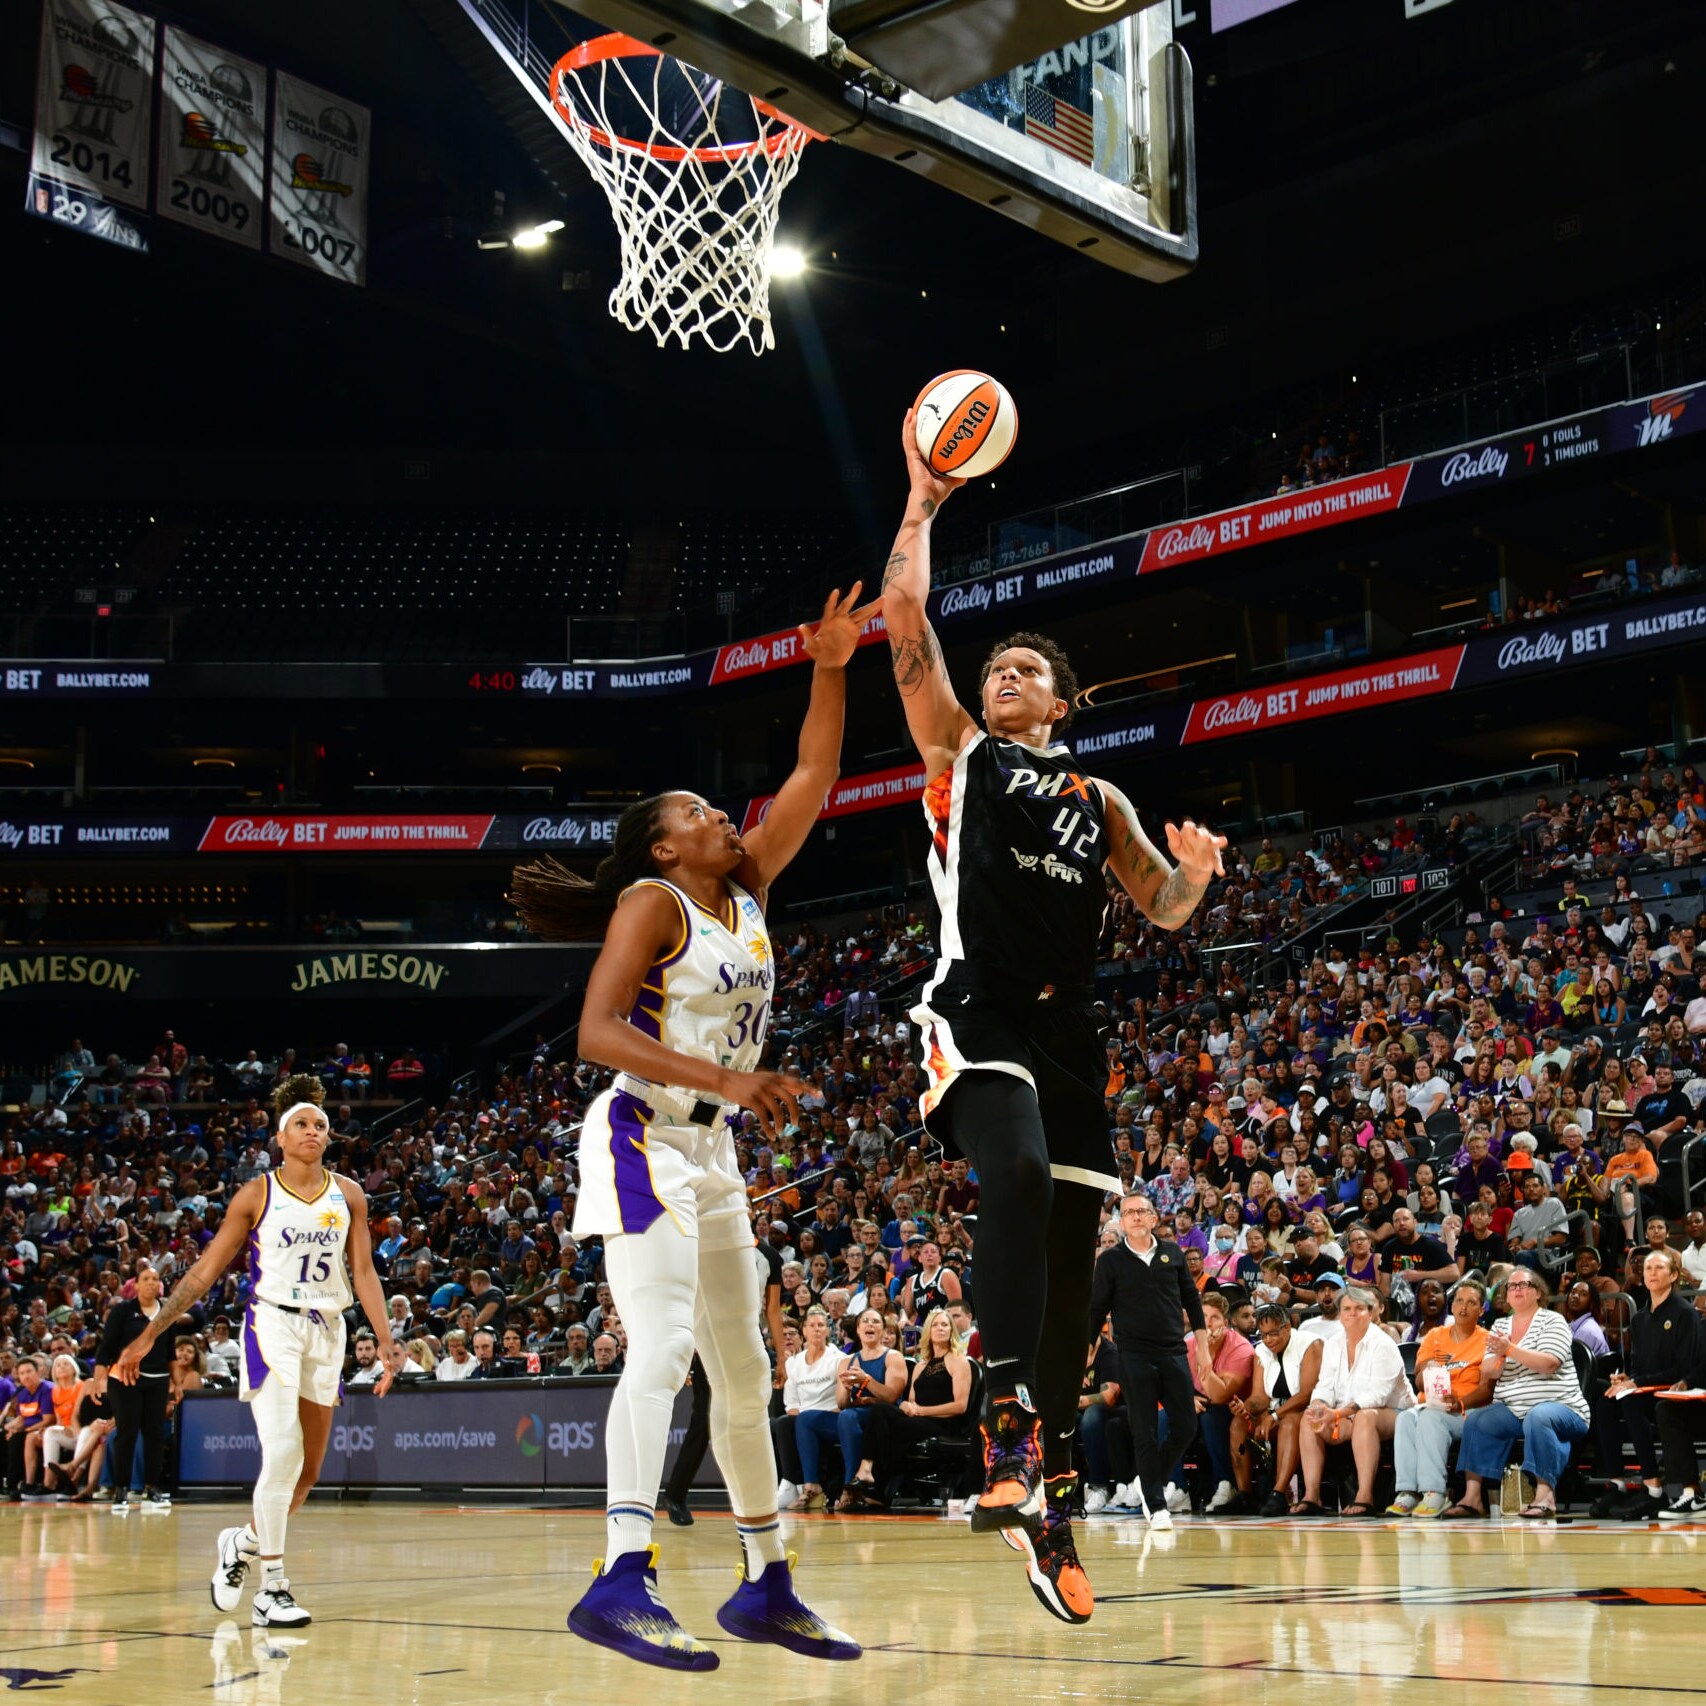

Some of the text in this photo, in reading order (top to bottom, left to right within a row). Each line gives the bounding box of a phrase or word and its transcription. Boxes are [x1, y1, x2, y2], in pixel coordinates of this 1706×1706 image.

[55, 26, 140, 72] CHAMPIONS
[174, 76, 254, 117] CHAMPIONS
[285, 119, 359, 158] CHAMPIONS
[50, 134, 133, 190] 2014
[52, 194, 88, 225] 29
[170, 179, 250, 231] 2009
[283, 219, 356, 267] 2007
[938, 400, 991, 459] Wilson
[1552, 424, 1581, 445] FOULS
[1441, 447, 1508, 486] Bally
[1522, 441, 1535, 467] 7
[1543, 438, 1599, 467] 3 TIMEOUTS
[1157, 482, 1392, 560] Bally BET JUMP INTO THE THRILL
[940, 555, 1115, 617] Bally BET BALLYBET.COM
[724, 642, 770, 674] Bally
[772, 635, 798, 662] BET
[1497, 631, 1568, 670] Bally
[1571, 622, 1610, 655] BET
[5, 669, 43, 690] BET
[56, 672, 150, 688] BALLYBET.COM
[468, 672, 516, 691] 4:40
[561, 671, 596, 691] BET
[609, 667, 692, 689] BALLYBET.COM
[1203, 663, 1440, 731] Bally BET JUMP INTO THE THRILL
[1076, 724, 1155, 755] BALLYBET.COM
[835, 788, 861, 806] JUMP
[862, 782, 885, 801] INTO
[885, 778, 904, 796] THE
[904, 772, 926, 790] THRI
[1003, 768, 1093, 802] PHX
[28, 825, 64, 845] BET
[77, 828, 171, 842] BALLYBET.COM
[223, 819, 469, 847] Bally BET JUMP INTO THE THRILL
[523, 817, 586, 845] Bally
[1051, 807, 1101, 859] 42
[1375, 880, 1391, 895] 101
[291, 952, 445, 991] JAMESON
[727, 999, 770, 1049] 30
[295, 1251, 334, 1284] 15
[333, 1424, 376, 1458] aps
[394, 1426, 497, 1452] aps.com/save
[547, 1421, 598, 1457] aps
